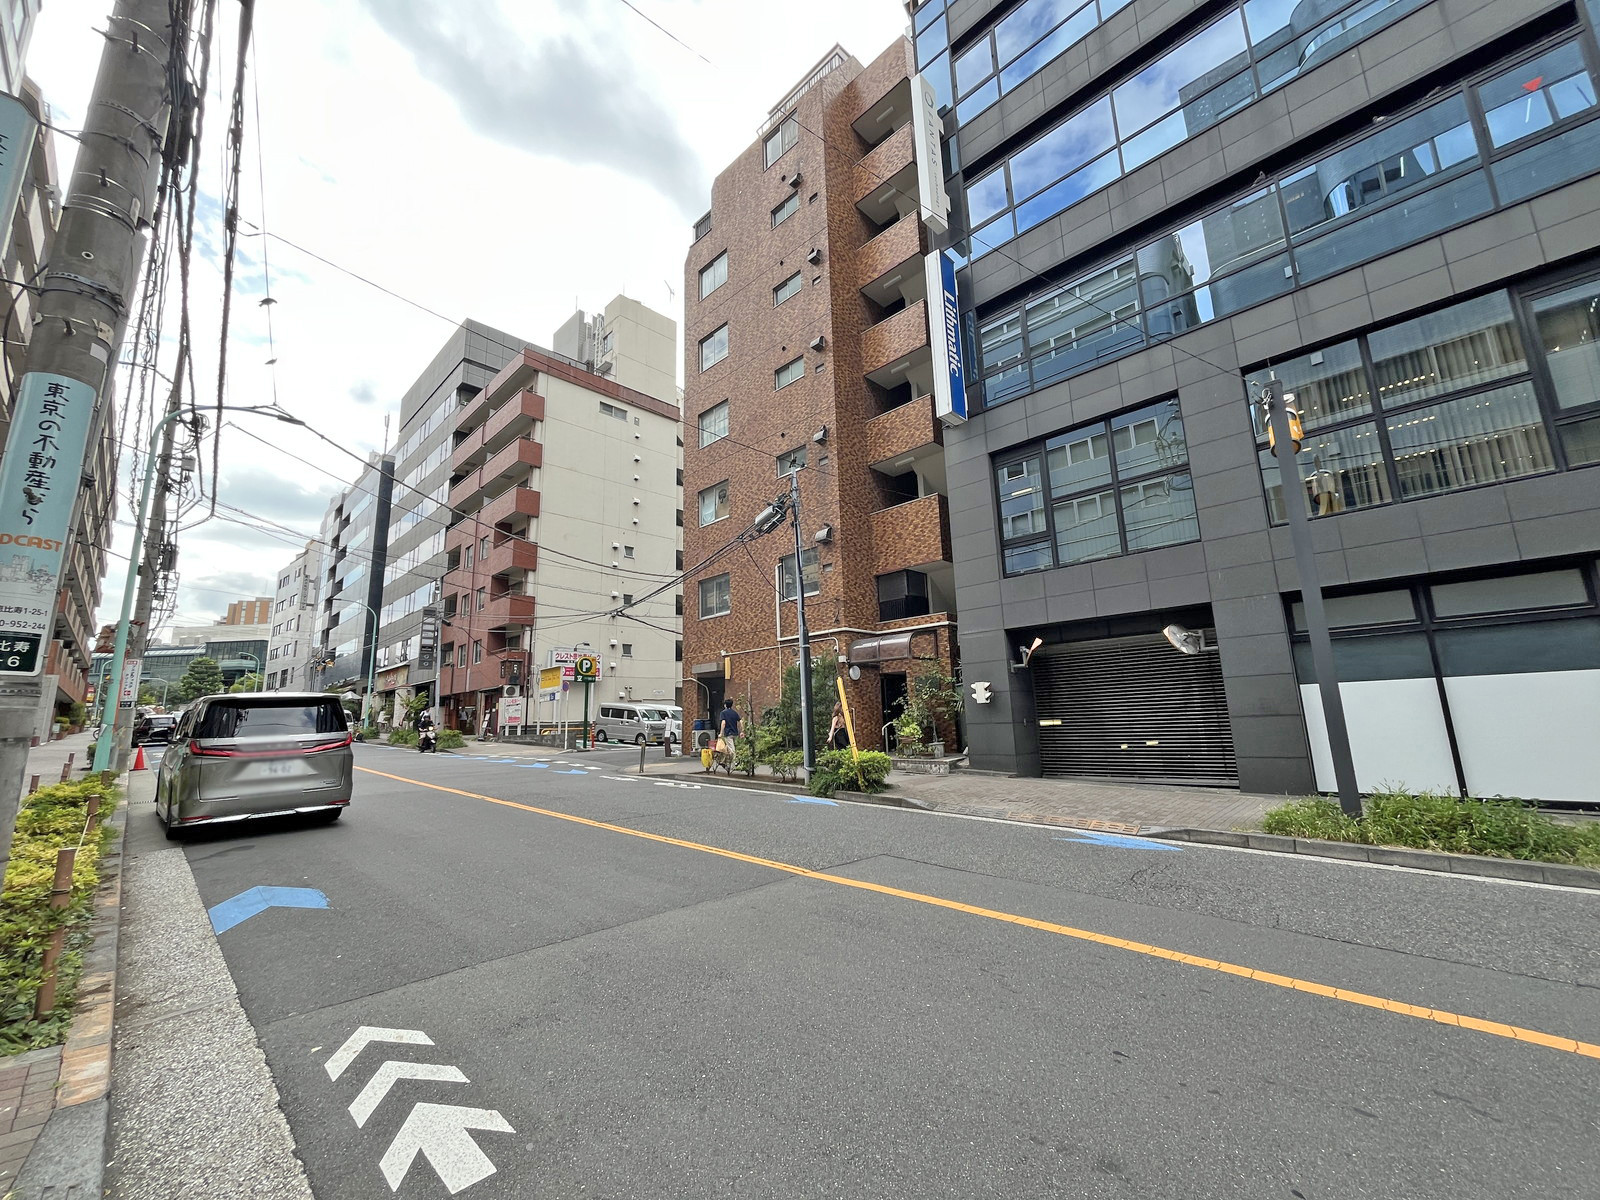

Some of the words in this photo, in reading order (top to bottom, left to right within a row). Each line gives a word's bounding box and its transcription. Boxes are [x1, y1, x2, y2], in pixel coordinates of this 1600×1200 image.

[928, 111, 938, 167] FANTAS
[943, 289, 961, 377] Lithmatic
[582, 660, 591, 672] P
